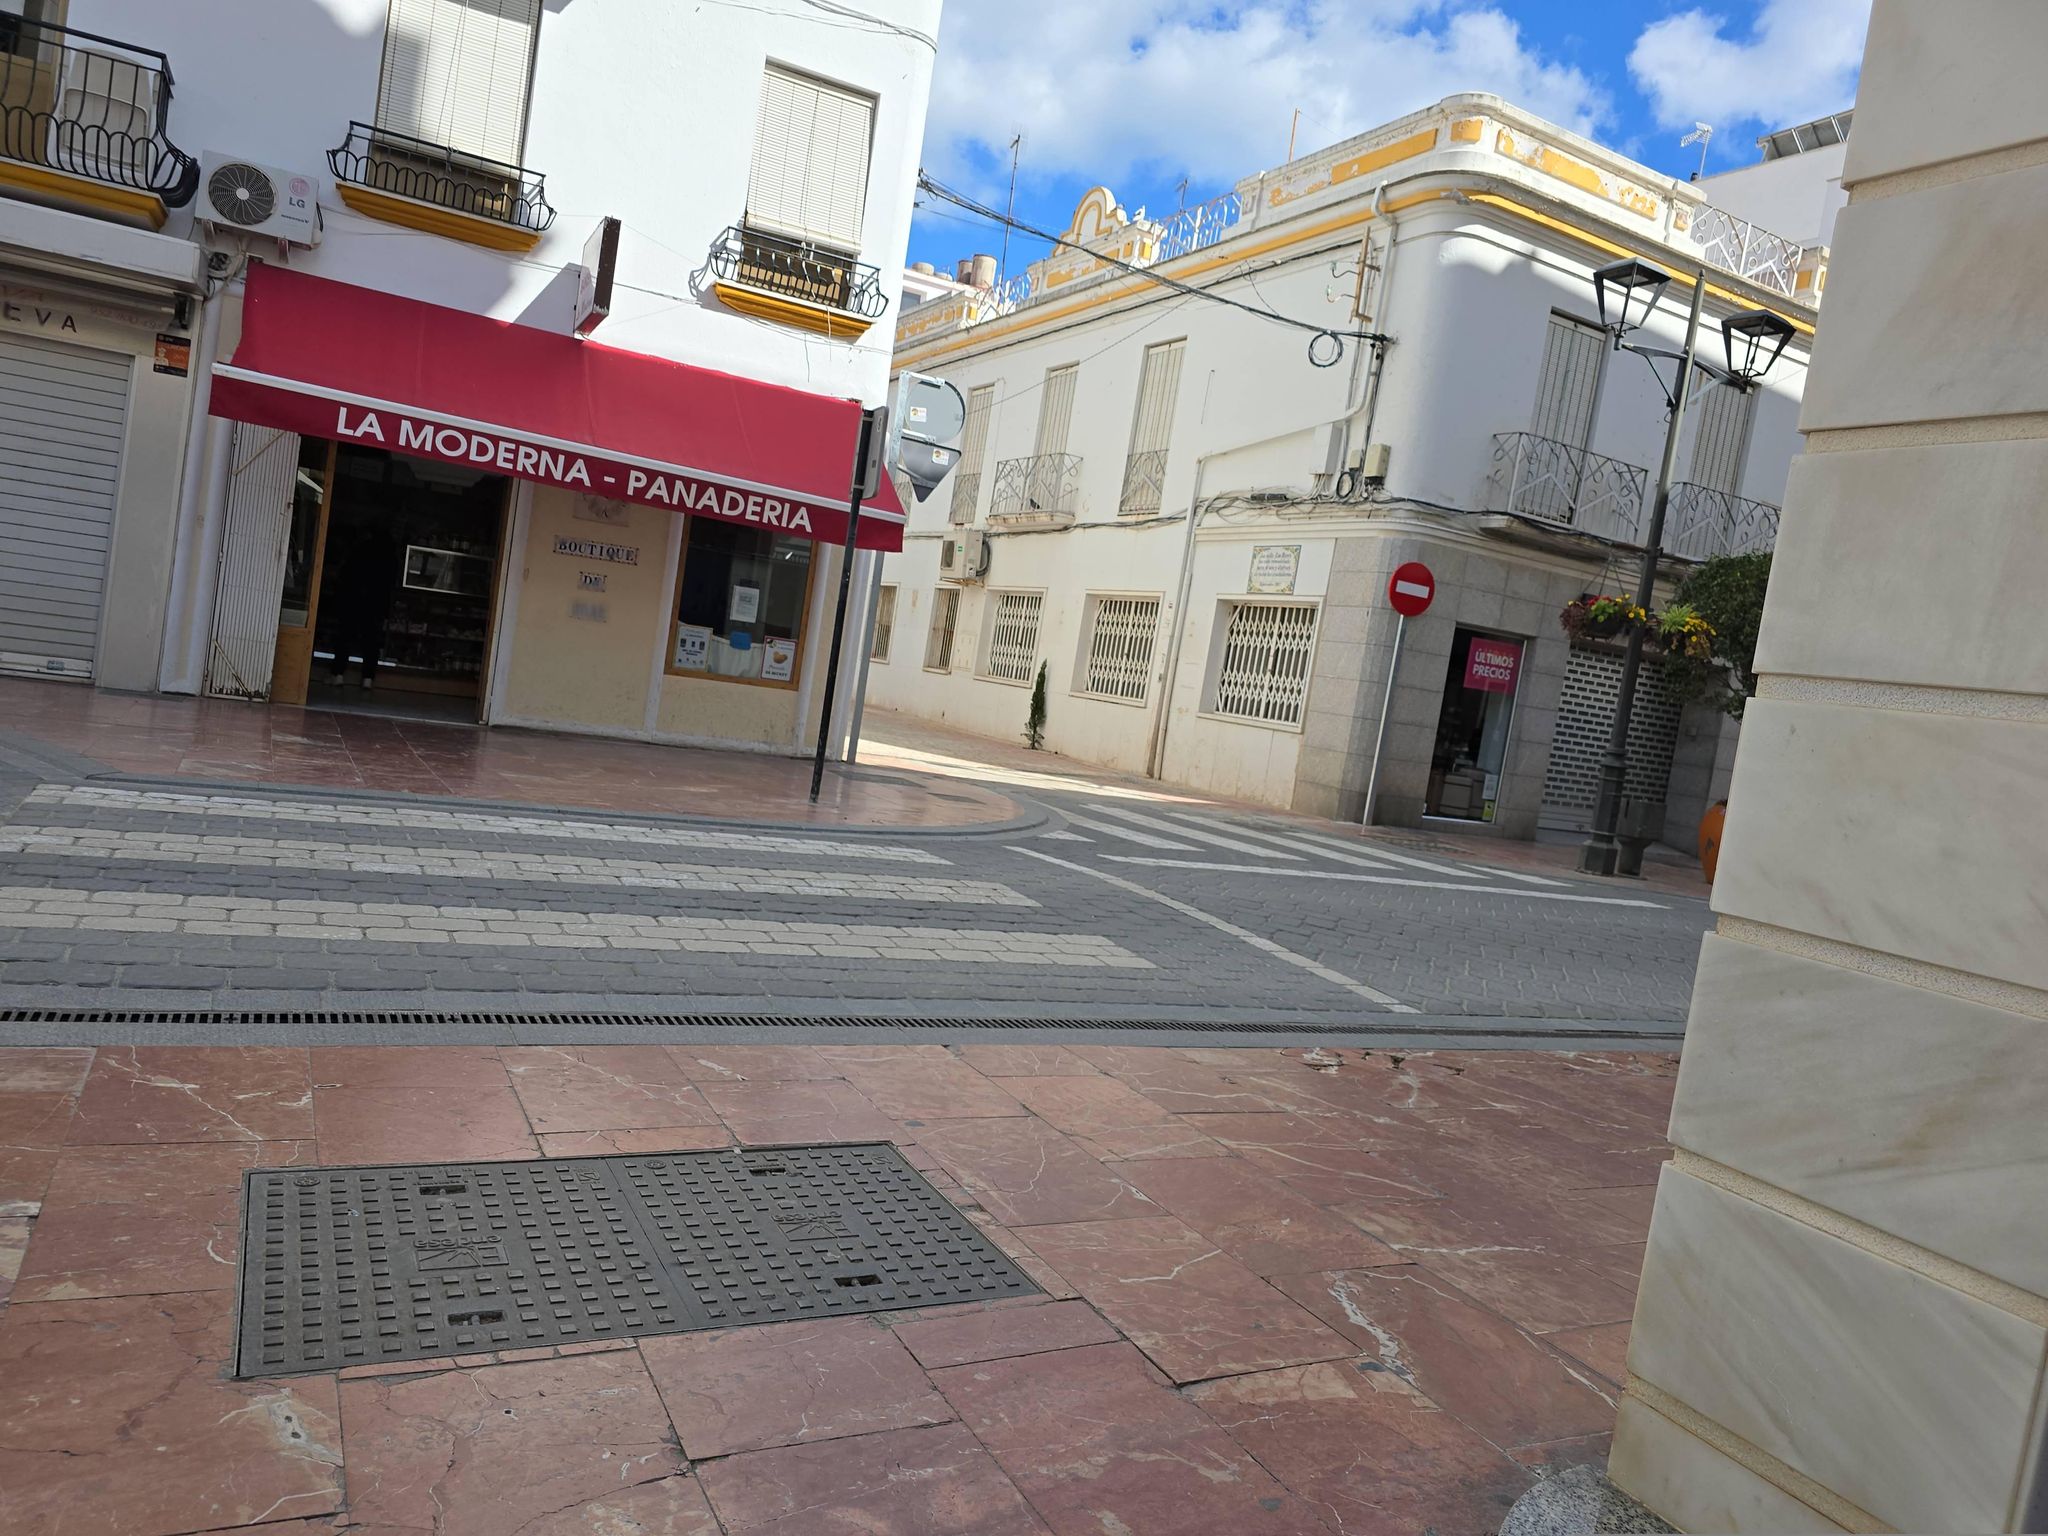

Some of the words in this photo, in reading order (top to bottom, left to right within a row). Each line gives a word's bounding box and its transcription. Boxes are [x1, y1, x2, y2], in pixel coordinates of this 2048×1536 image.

[289, 196, 305, 209] LG
[3, 302, 78, 333] EVA
[336, 406, 385, 442] LA
[398, 419, 592, 487] MODERNA
[603, 475, 616, 484] -
[626, 469, 813, 533] PANADERIA
[559, 539, 635, 562] BOUTIQUE
[1475, 648, 1514, 668] ÚLTIMOS
[1472, 664, 1511, 681] PRECIOS
[413, 1234, 503, 1249] endesa
